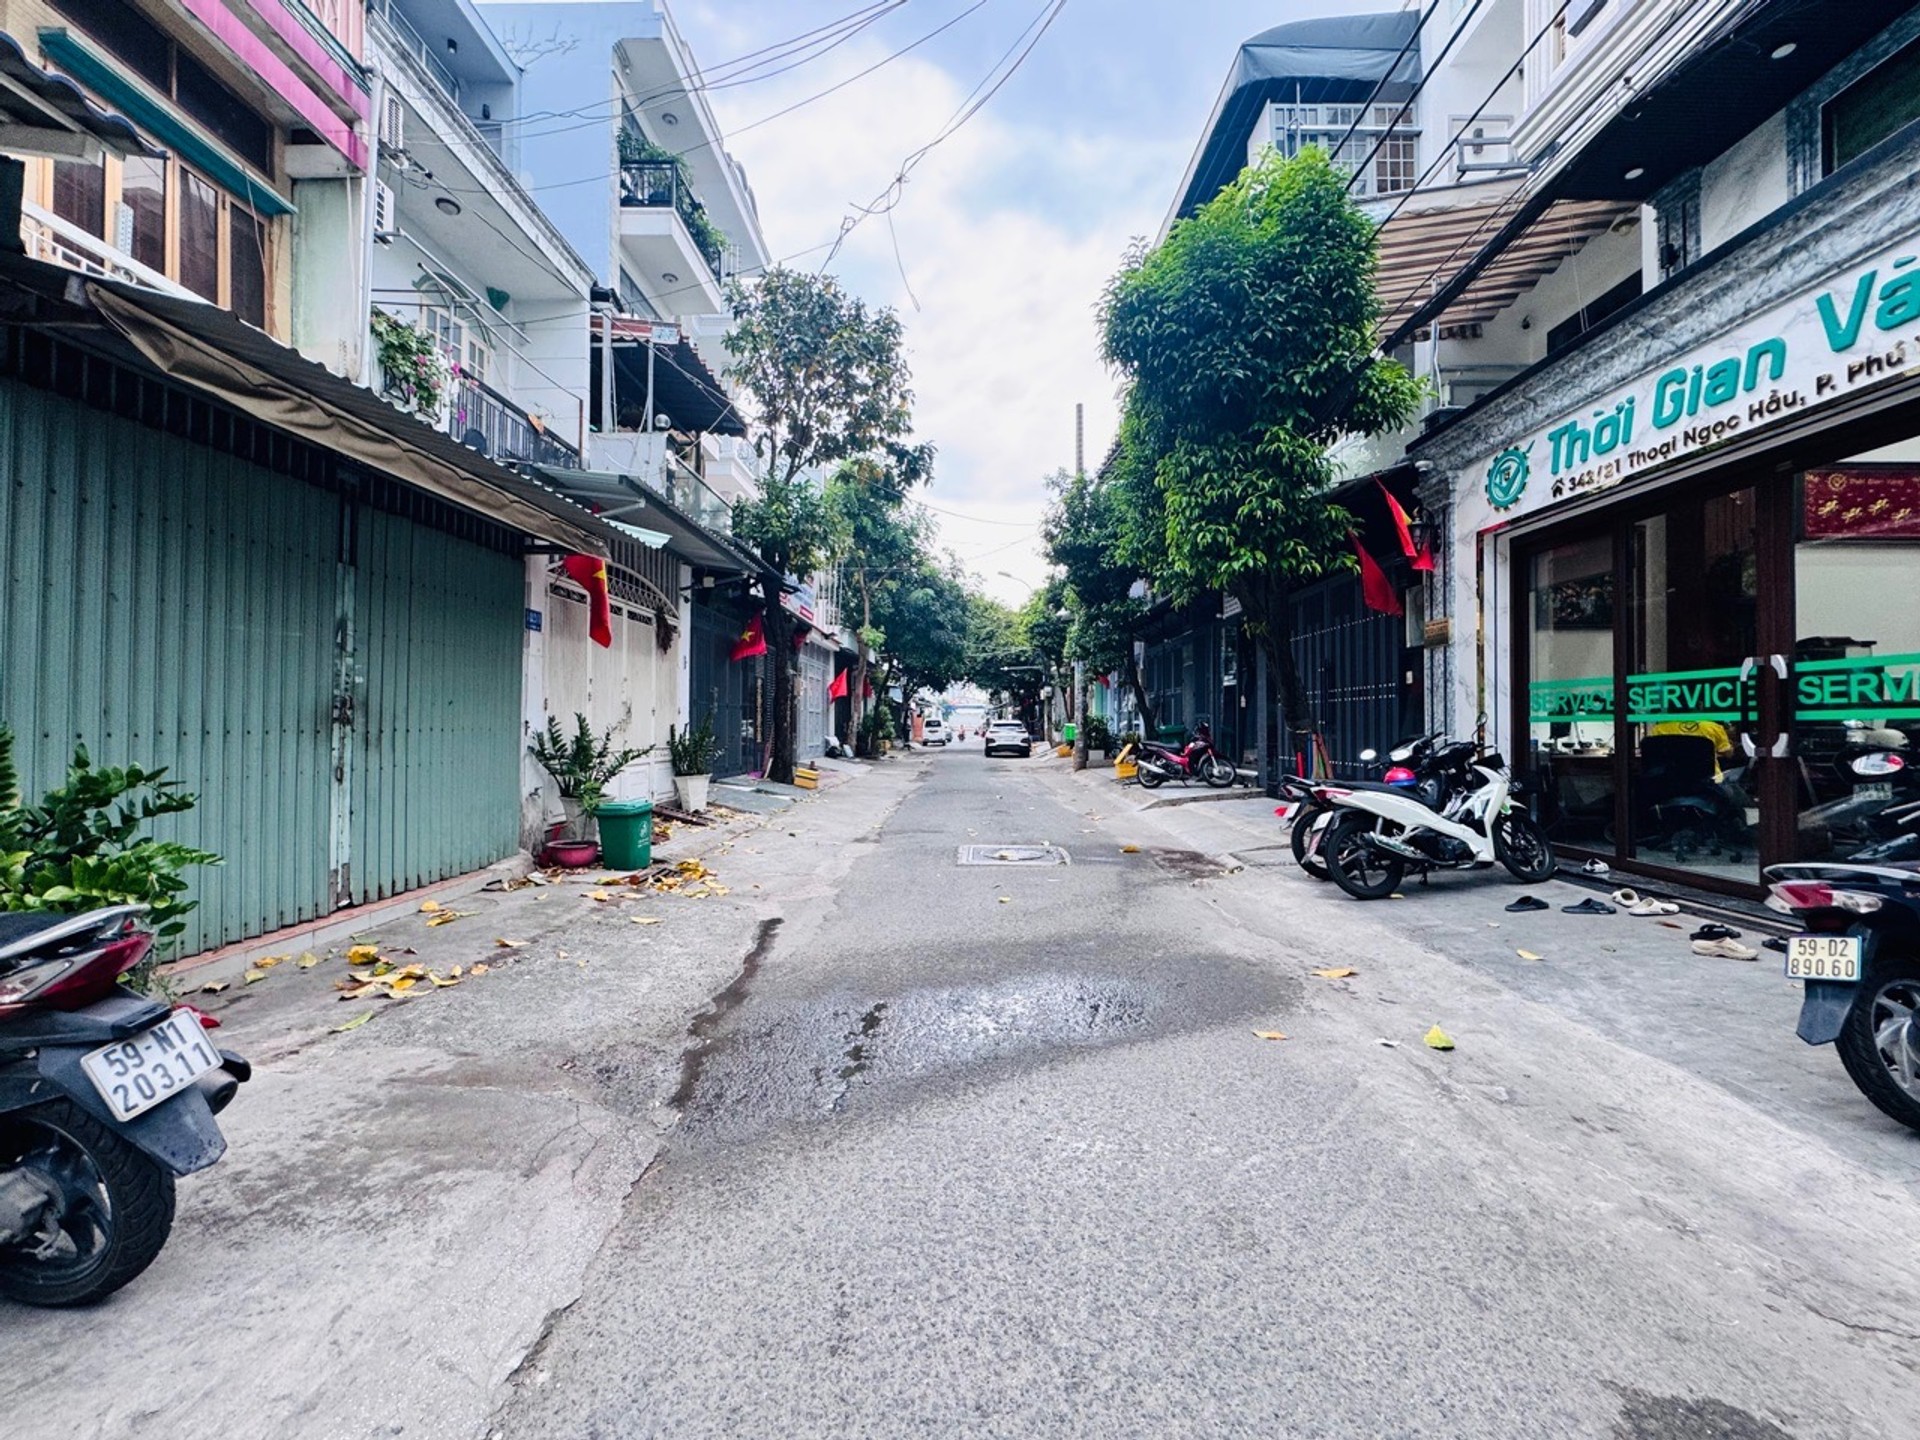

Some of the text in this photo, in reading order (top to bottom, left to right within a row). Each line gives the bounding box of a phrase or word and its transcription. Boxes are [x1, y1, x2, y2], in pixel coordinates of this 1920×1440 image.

[1548, 395, 1635, 475] Thời
[1651, 337, 1786, 430] Gian
[1627, 435, 1677, 468] Thoại
[1683, 415, 1741, 447] Ngọc
[1816, 373, 1837, 395] P.
[1847, 340, 1906, 384] Phú
[1531, 688, 1615, 713] SERVICE
[1628, 680, 1757, 709] SERVICE
[1791, 958, 1855, 977] 890.60
[1798, 939, 1848, 957] 59-D2
[102, 1021, 188, 1077] 59-N1
[112, 1042, 212, 1113] 203.11
